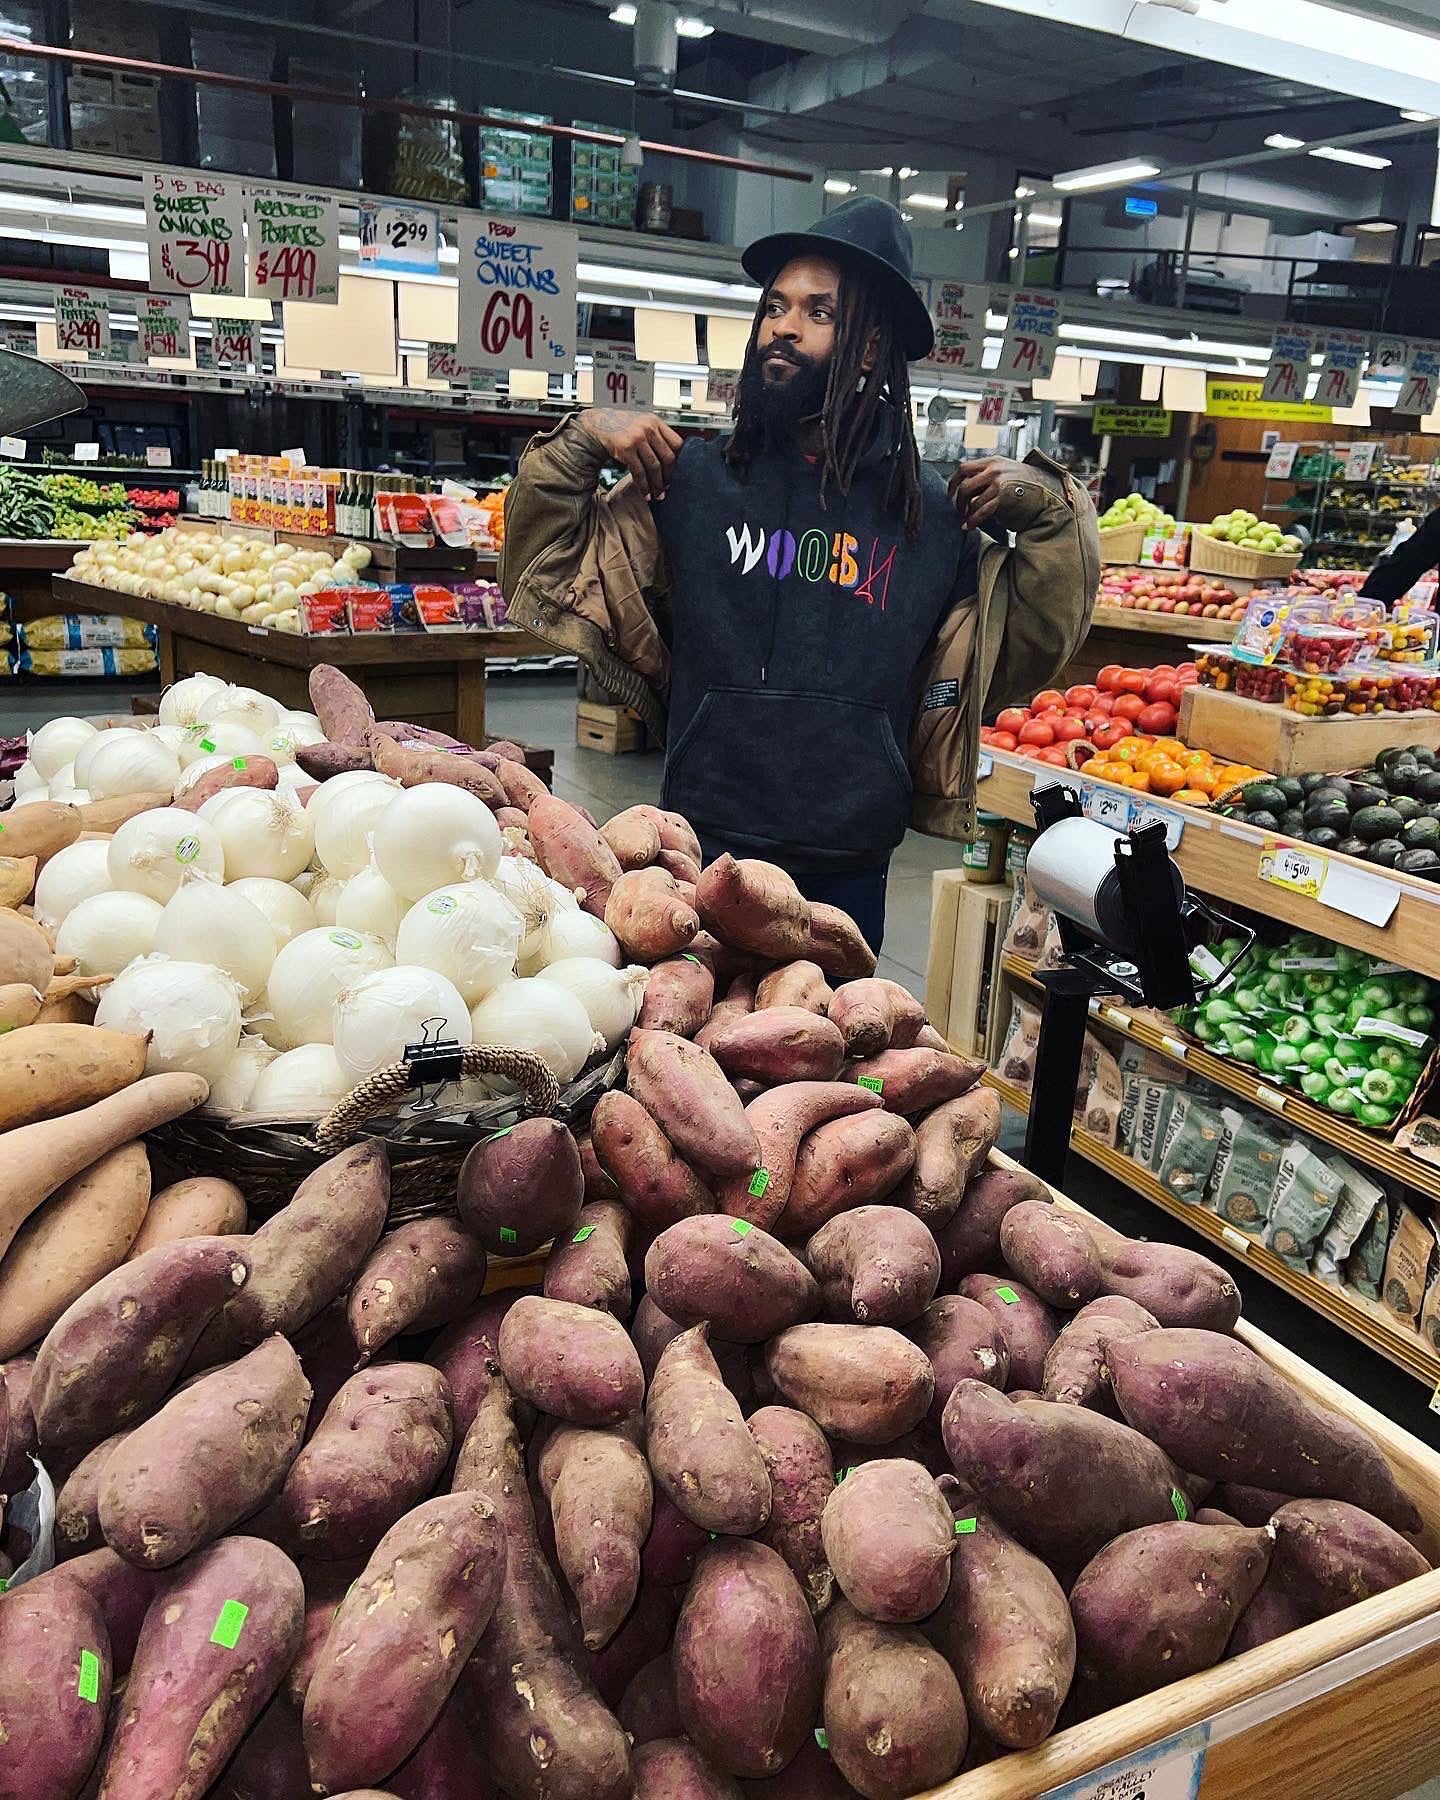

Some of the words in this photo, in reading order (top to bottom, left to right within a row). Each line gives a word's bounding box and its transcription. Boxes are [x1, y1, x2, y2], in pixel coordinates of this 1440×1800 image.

[195, 180, 225, 196] BAG
[153, 193, 218, 215] SWEET
[159, 215, 233, 240] ONIONS
[474, 236, 544, 264] SWEET
[477, 260, 560, 295] ONIONS
[1141, 1087, 1161, 1149] ORGANIC
